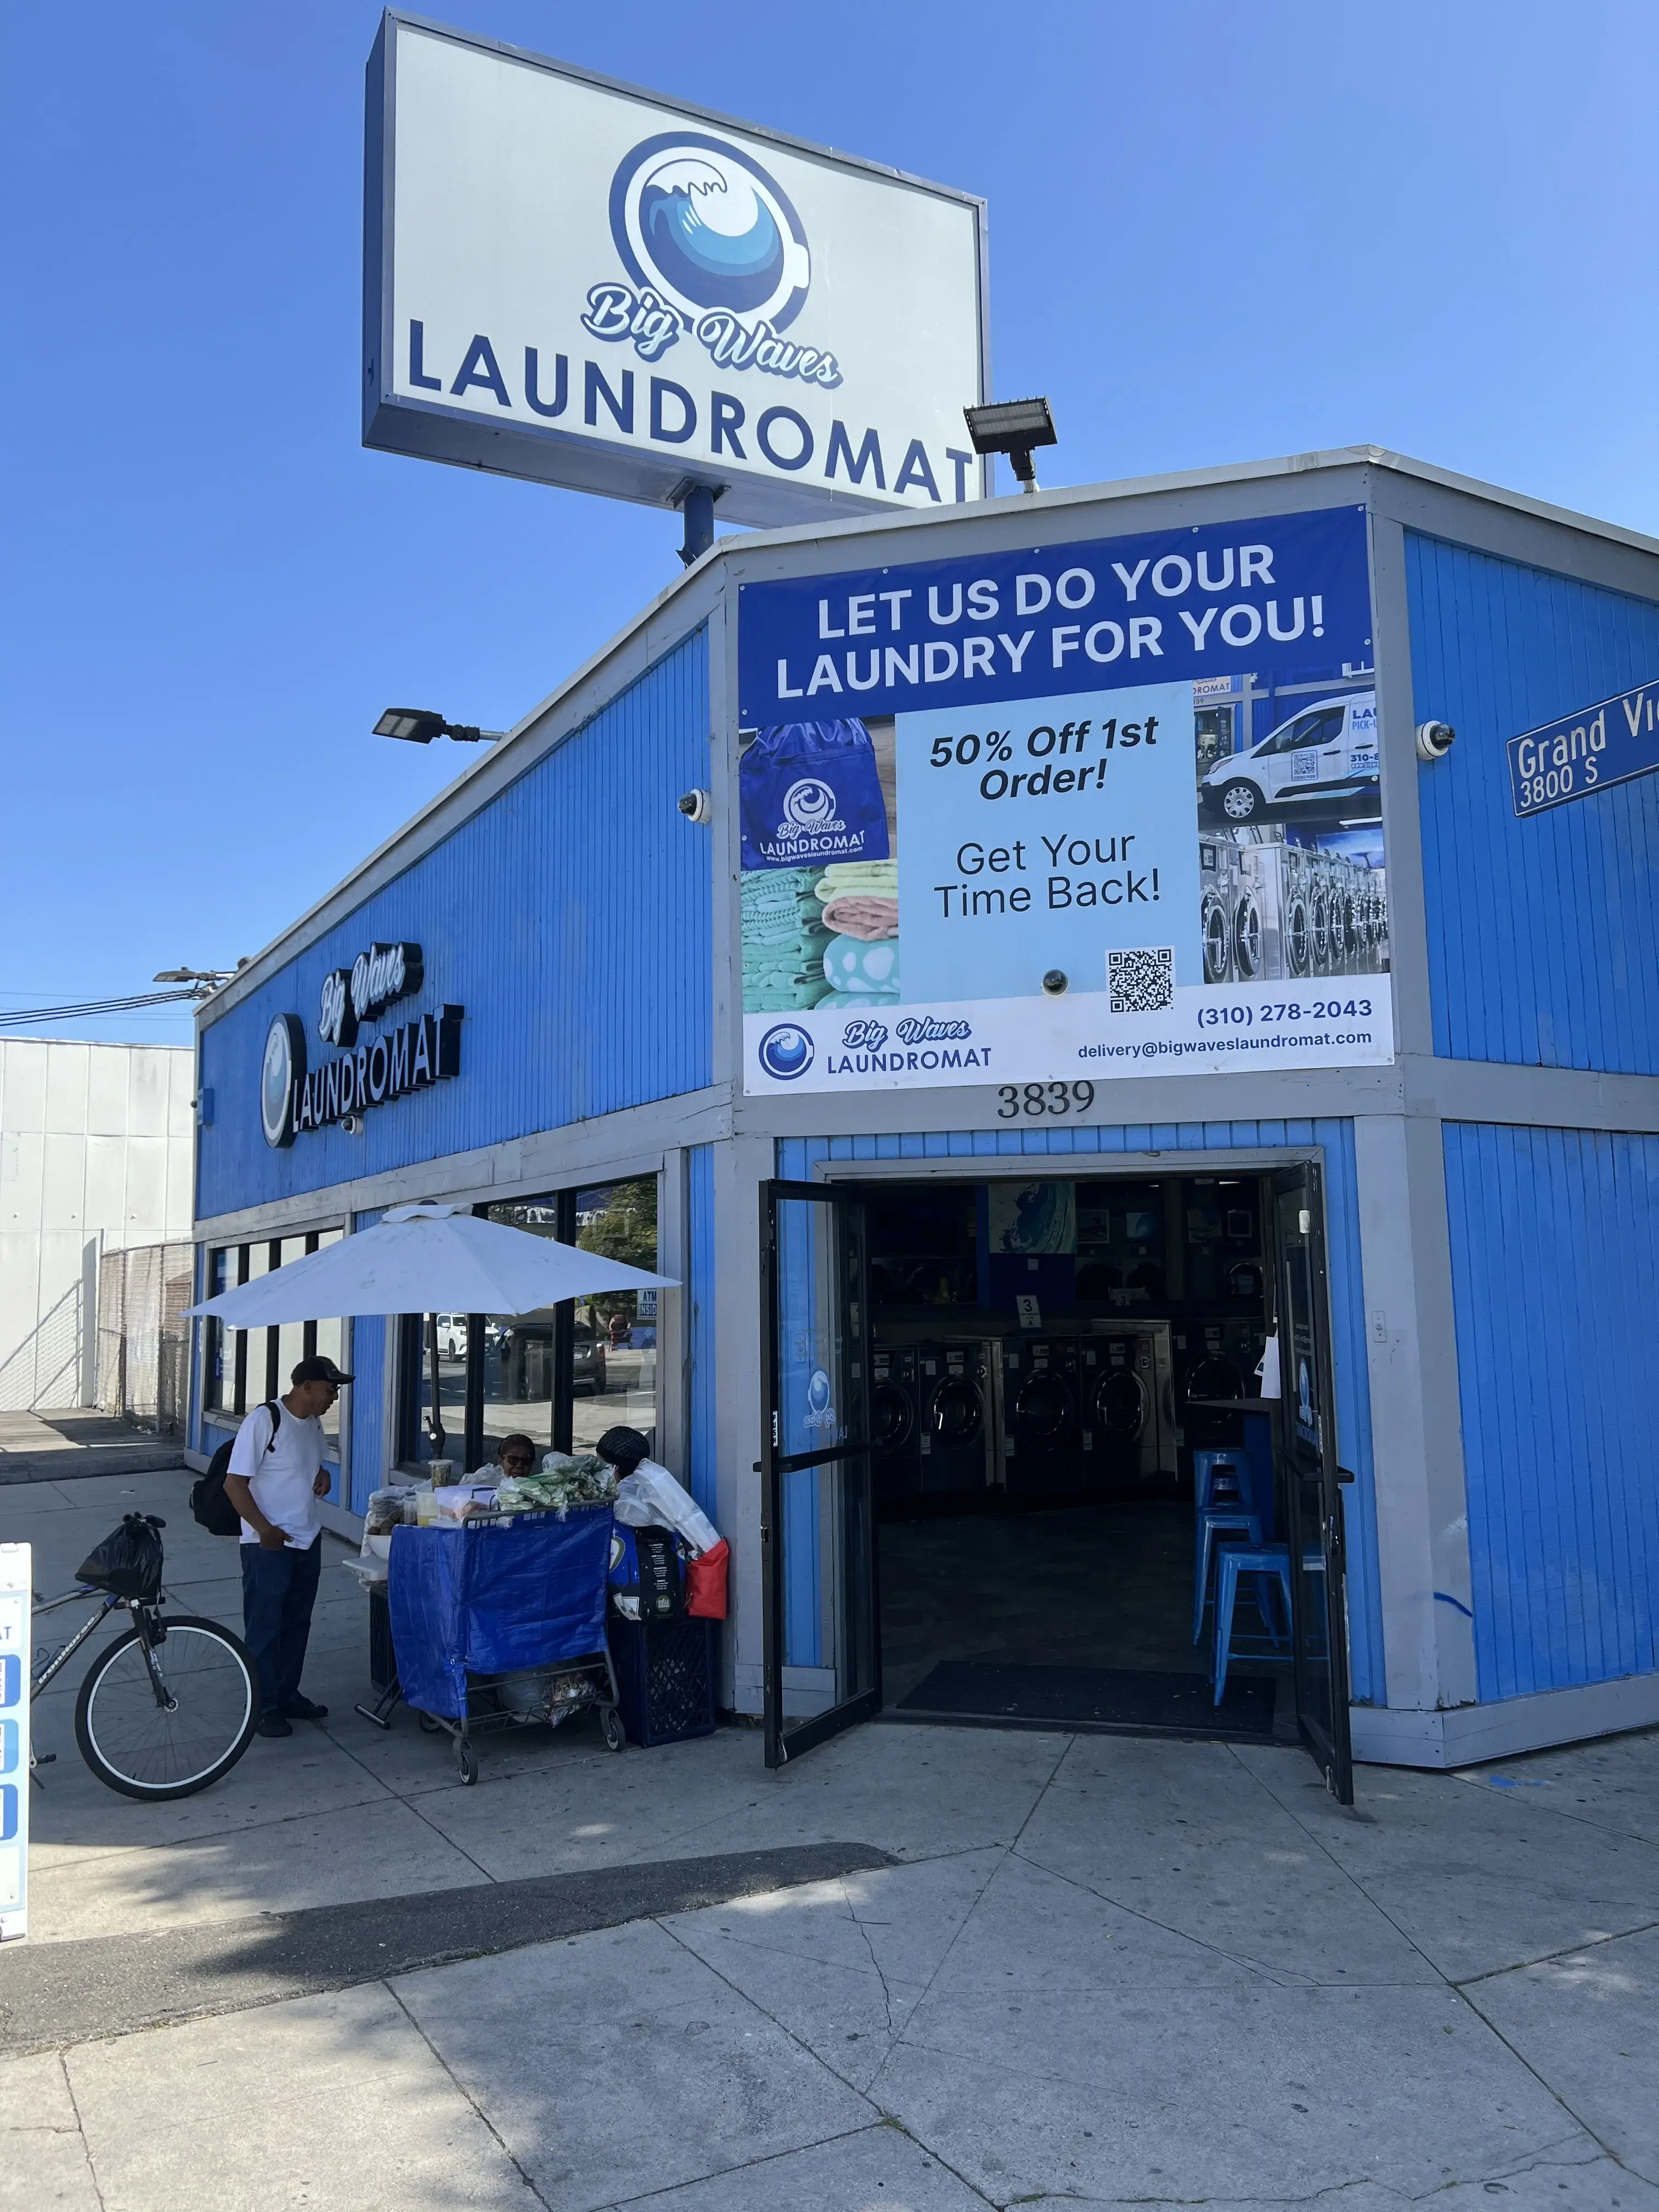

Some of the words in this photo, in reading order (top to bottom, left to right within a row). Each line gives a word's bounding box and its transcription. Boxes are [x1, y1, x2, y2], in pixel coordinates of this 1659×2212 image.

[582, 282, 682, 362] Big
[695, 308, 843, 388] Waves
[409, 319, 973, 504] LAUNDROMAT
[819, 589, 912, 639] LET
[928, 579, 1000, 625] US
[1016, 567, 1096, 616] DO
[1111, 544, 1276, 602] YOUR
[777, 630, 1036, 699] LAUNDRY
[1052, 616, 1164, 668] FOR
[1178, 595, 1325, 652] YOU!
[930, 730, 1013, 768] 50%
[1027, 720, 1093, 758] Off
[1102, 716, 1159, 749] 1st
[1518, 708, 1606, 779] Grand
[1622, 692, 1659, 737] Vi
[980, 758, 1107, 800] Order!
[1520, 768, 1573, 808] 3800
[1585, 756, 1598, 785] S
[760, 830, 865, 857] LAUNDROMAT
[776, 821, 802, 840] Big
[805, 819, 846, 835] Waves
[957, 840, 1026, 875] Get
[1040, 833, 1136, 867] Your
[934, 884, 1031, 918] Time
[1048, 868, 1160, 910] Back!
[319, 968, 350, 1047] Big
[351, 942, 413, 1022] Waves
[1197, 1005, 1253, 1029] (310)
[1260, 999, 1373, 1023] 278-2043
[843, 1020, 888, 1052] Big
[896, 1016, 972, 1042] Waves
[1078, 1031, 1372, 1059] delivery@bigwaveslaundromat.com
[292, 1004, 454, 1132] LAUNDROMAT
[827, 1048, 991, 1074] LAUNDROMAT
[997, 1080, 1094, 1118] 3839
[639, 1304, 657, 1316] INSID
[643, 1291, 657, 1301] ATM
[1023, 1299, 1032, 1312] 3
